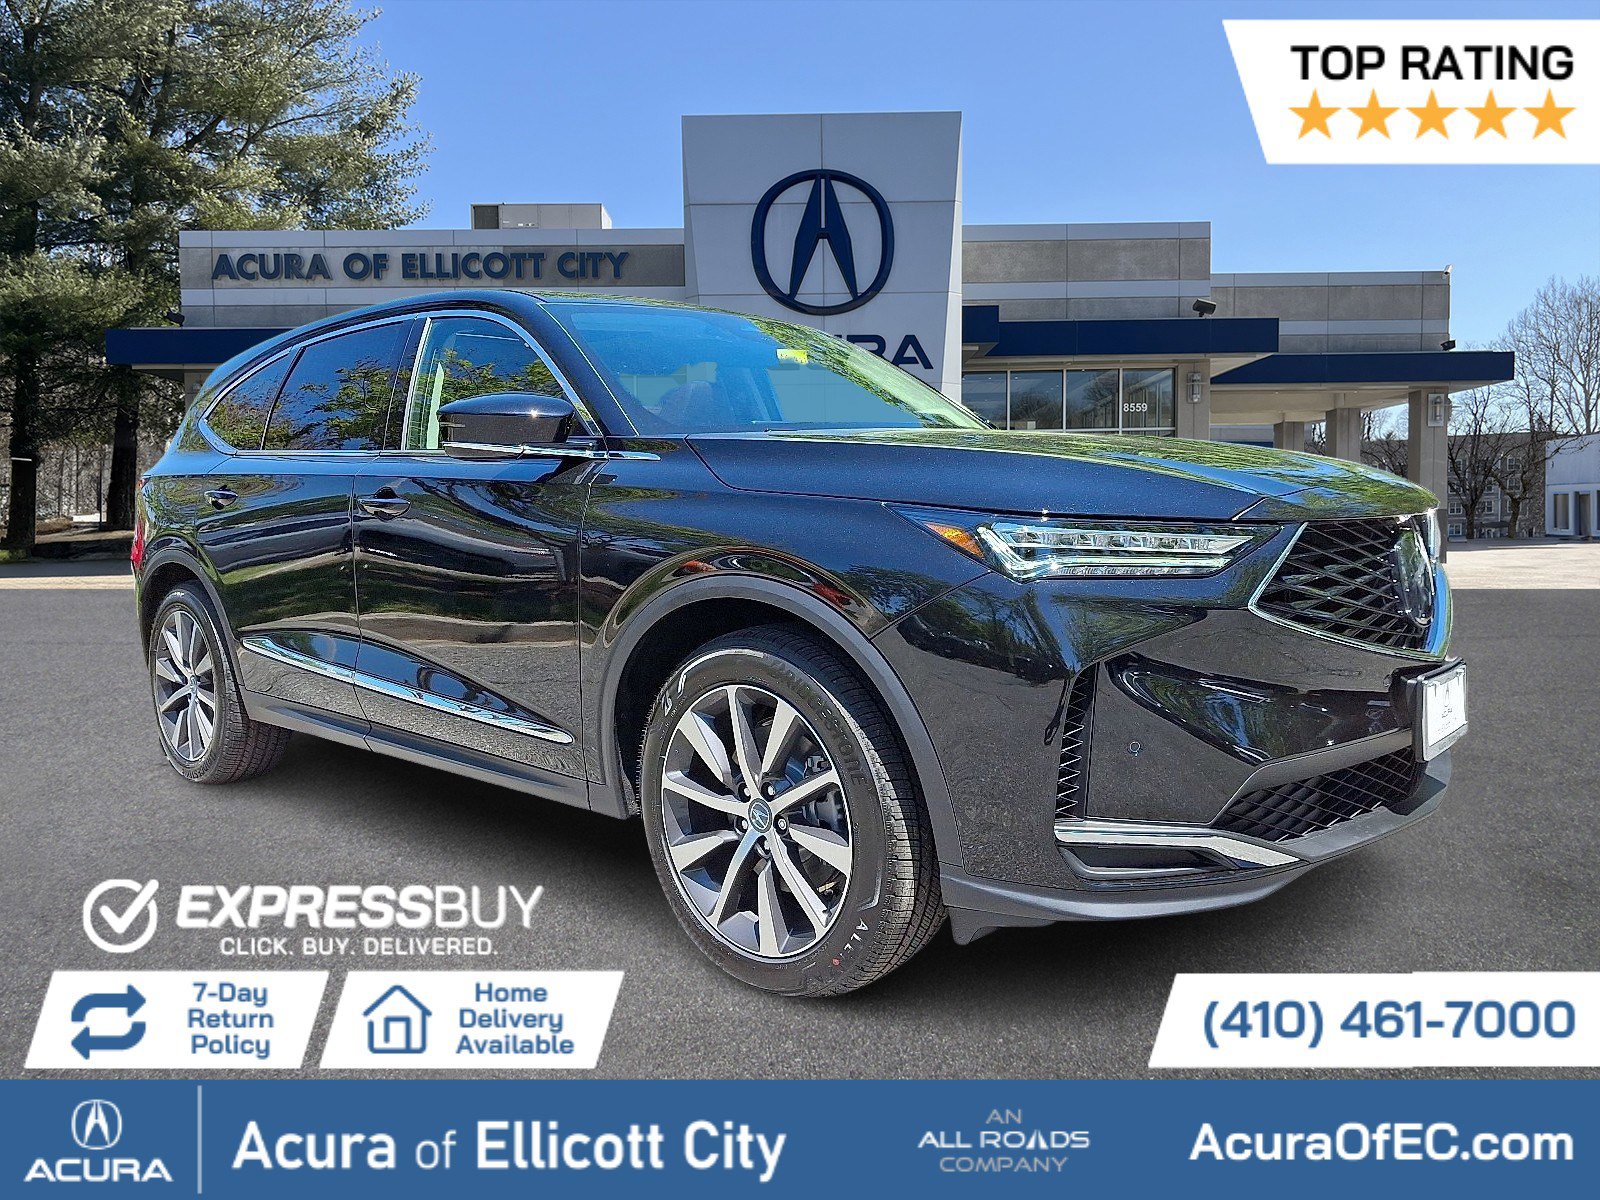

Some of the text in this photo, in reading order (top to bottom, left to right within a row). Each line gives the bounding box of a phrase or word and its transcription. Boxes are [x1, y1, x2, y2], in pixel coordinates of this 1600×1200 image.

[211, 251, 629, 281] ACURA OF ELLICOTT CITY
[1122, 402, 1148, 413] 8559
